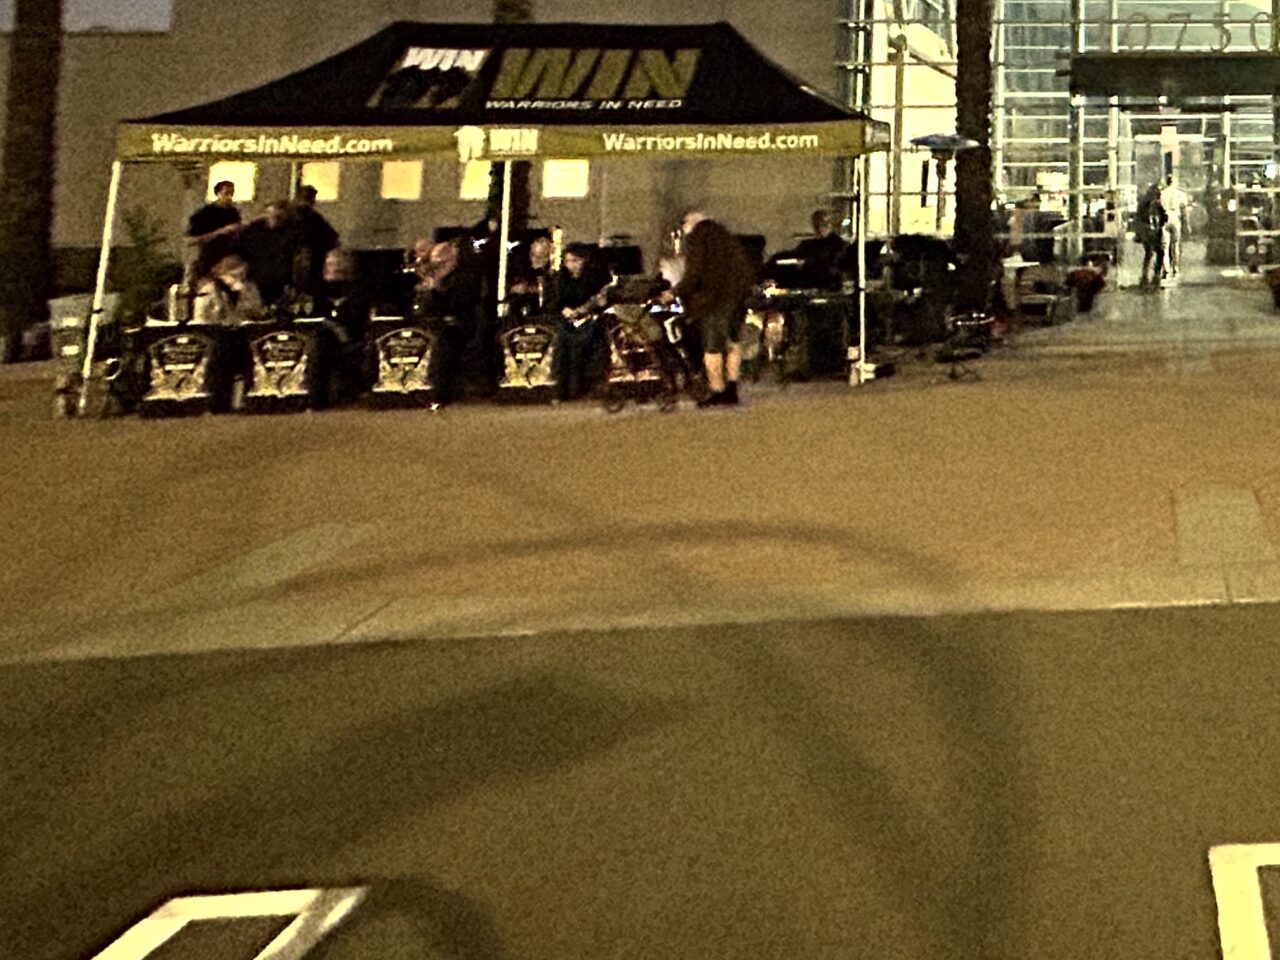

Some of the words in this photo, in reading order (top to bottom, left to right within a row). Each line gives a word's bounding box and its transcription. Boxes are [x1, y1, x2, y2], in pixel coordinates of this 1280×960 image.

[402, 47, 488, 71] WIN
[488, 48, 702, 99] WIN
[485, 99, 592, 109] WARRIORS
[599, 100, 621, 109] IN
[628, 100, 682, 109] NEED
[152, 133, 393, 153] WarriorsInNeed.com
[490, 129, 538, 152] WIN
[603, 132, 818, 150] WarriorsInNeed.com
